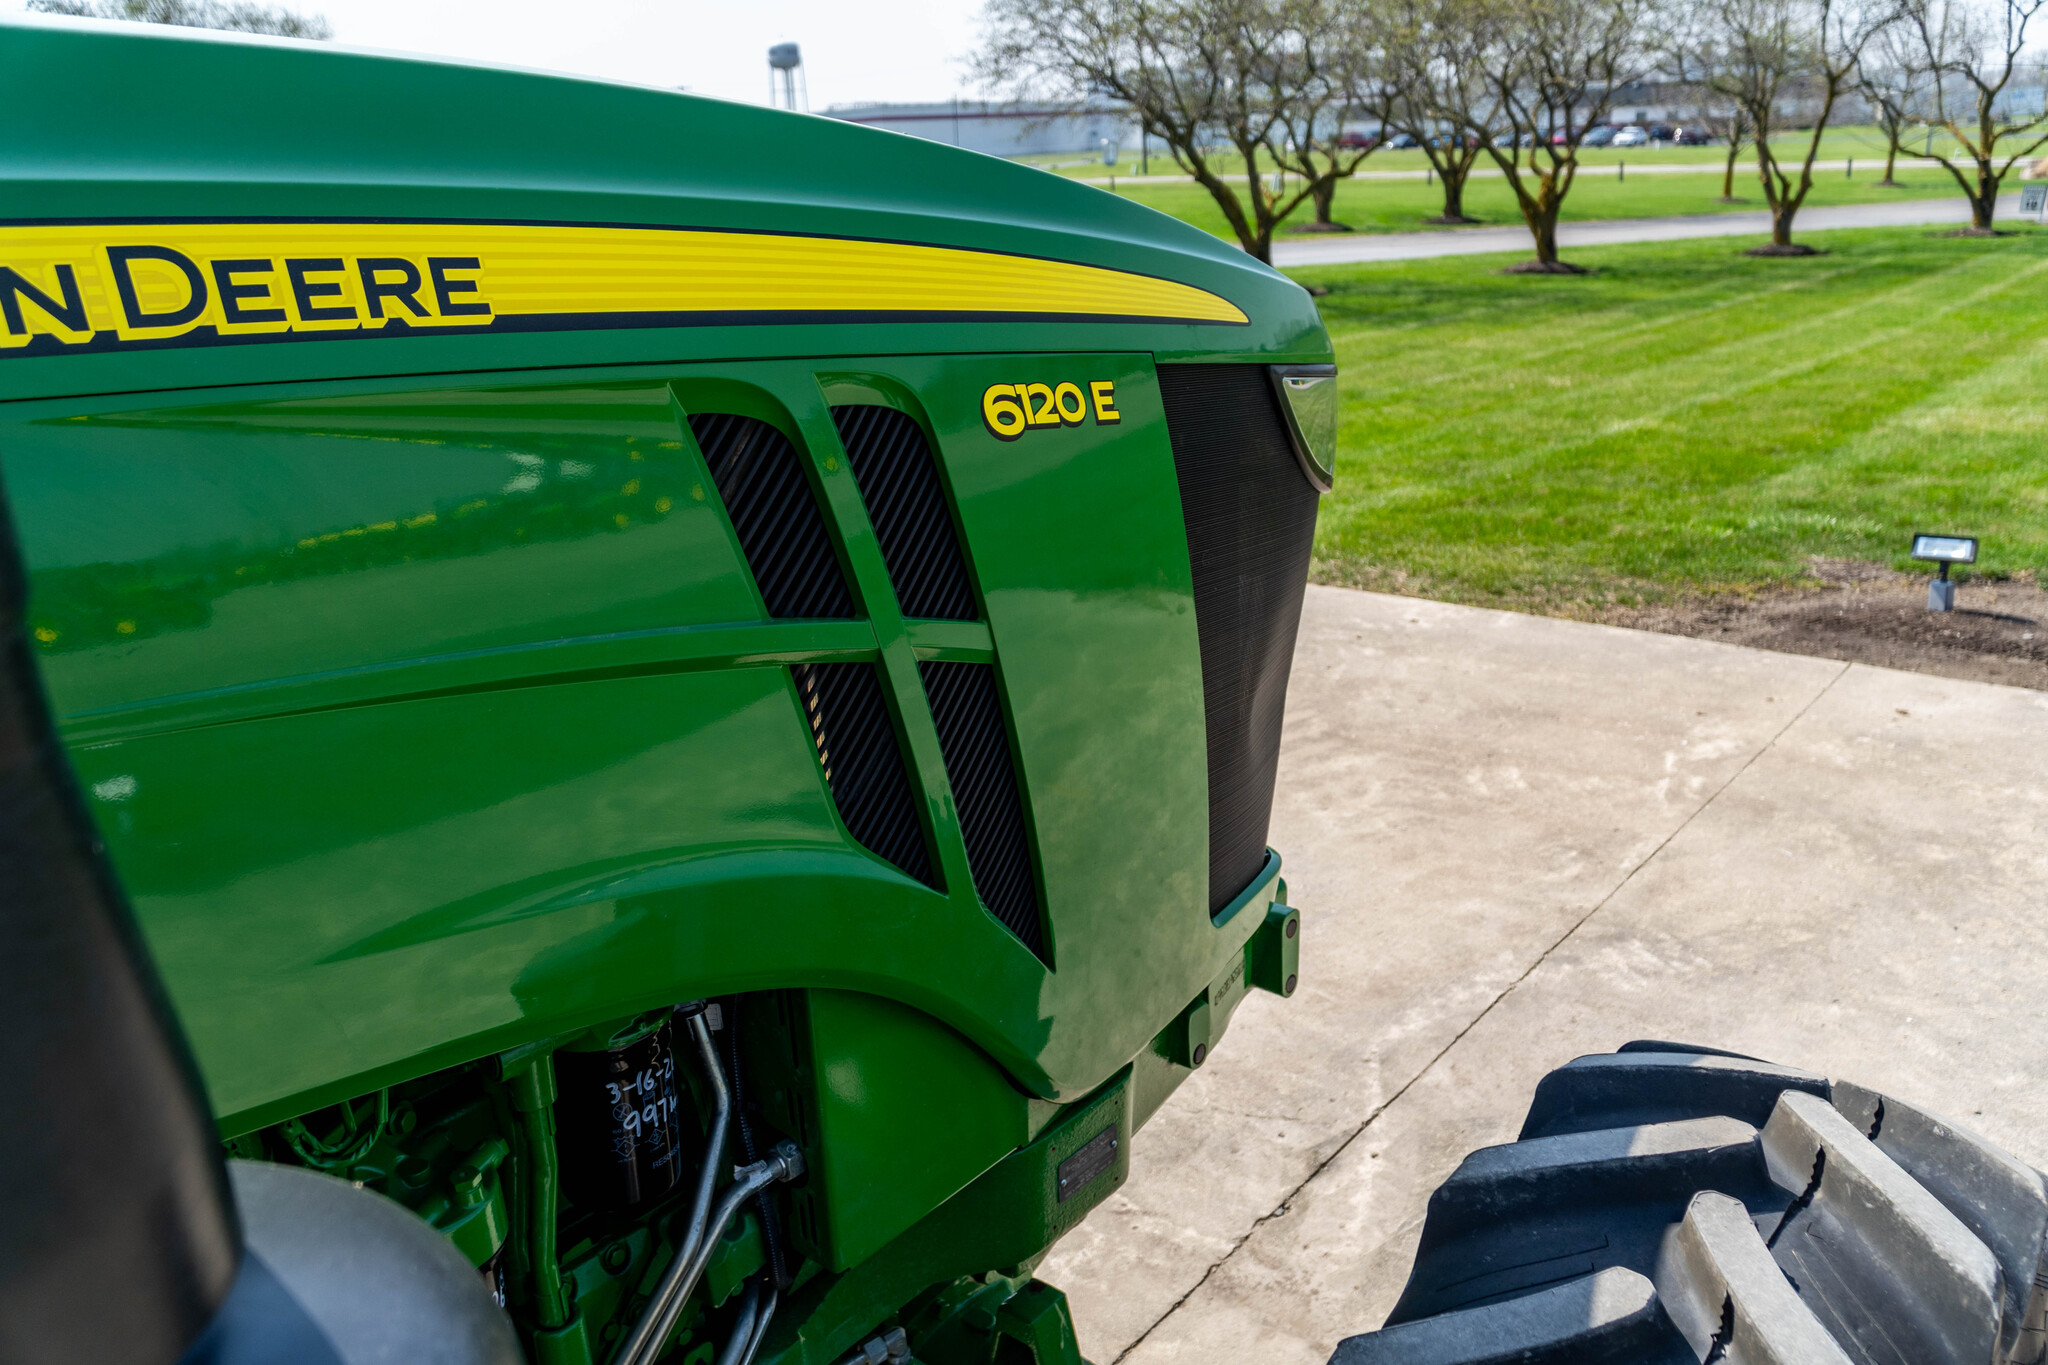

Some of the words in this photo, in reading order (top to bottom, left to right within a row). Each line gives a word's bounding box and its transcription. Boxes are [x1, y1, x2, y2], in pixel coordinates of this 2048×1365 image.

[104, 244, 494, 333] DEERE
[980, 380, 1087, 442] 6120
[1088, 380, 1121, 426] E
